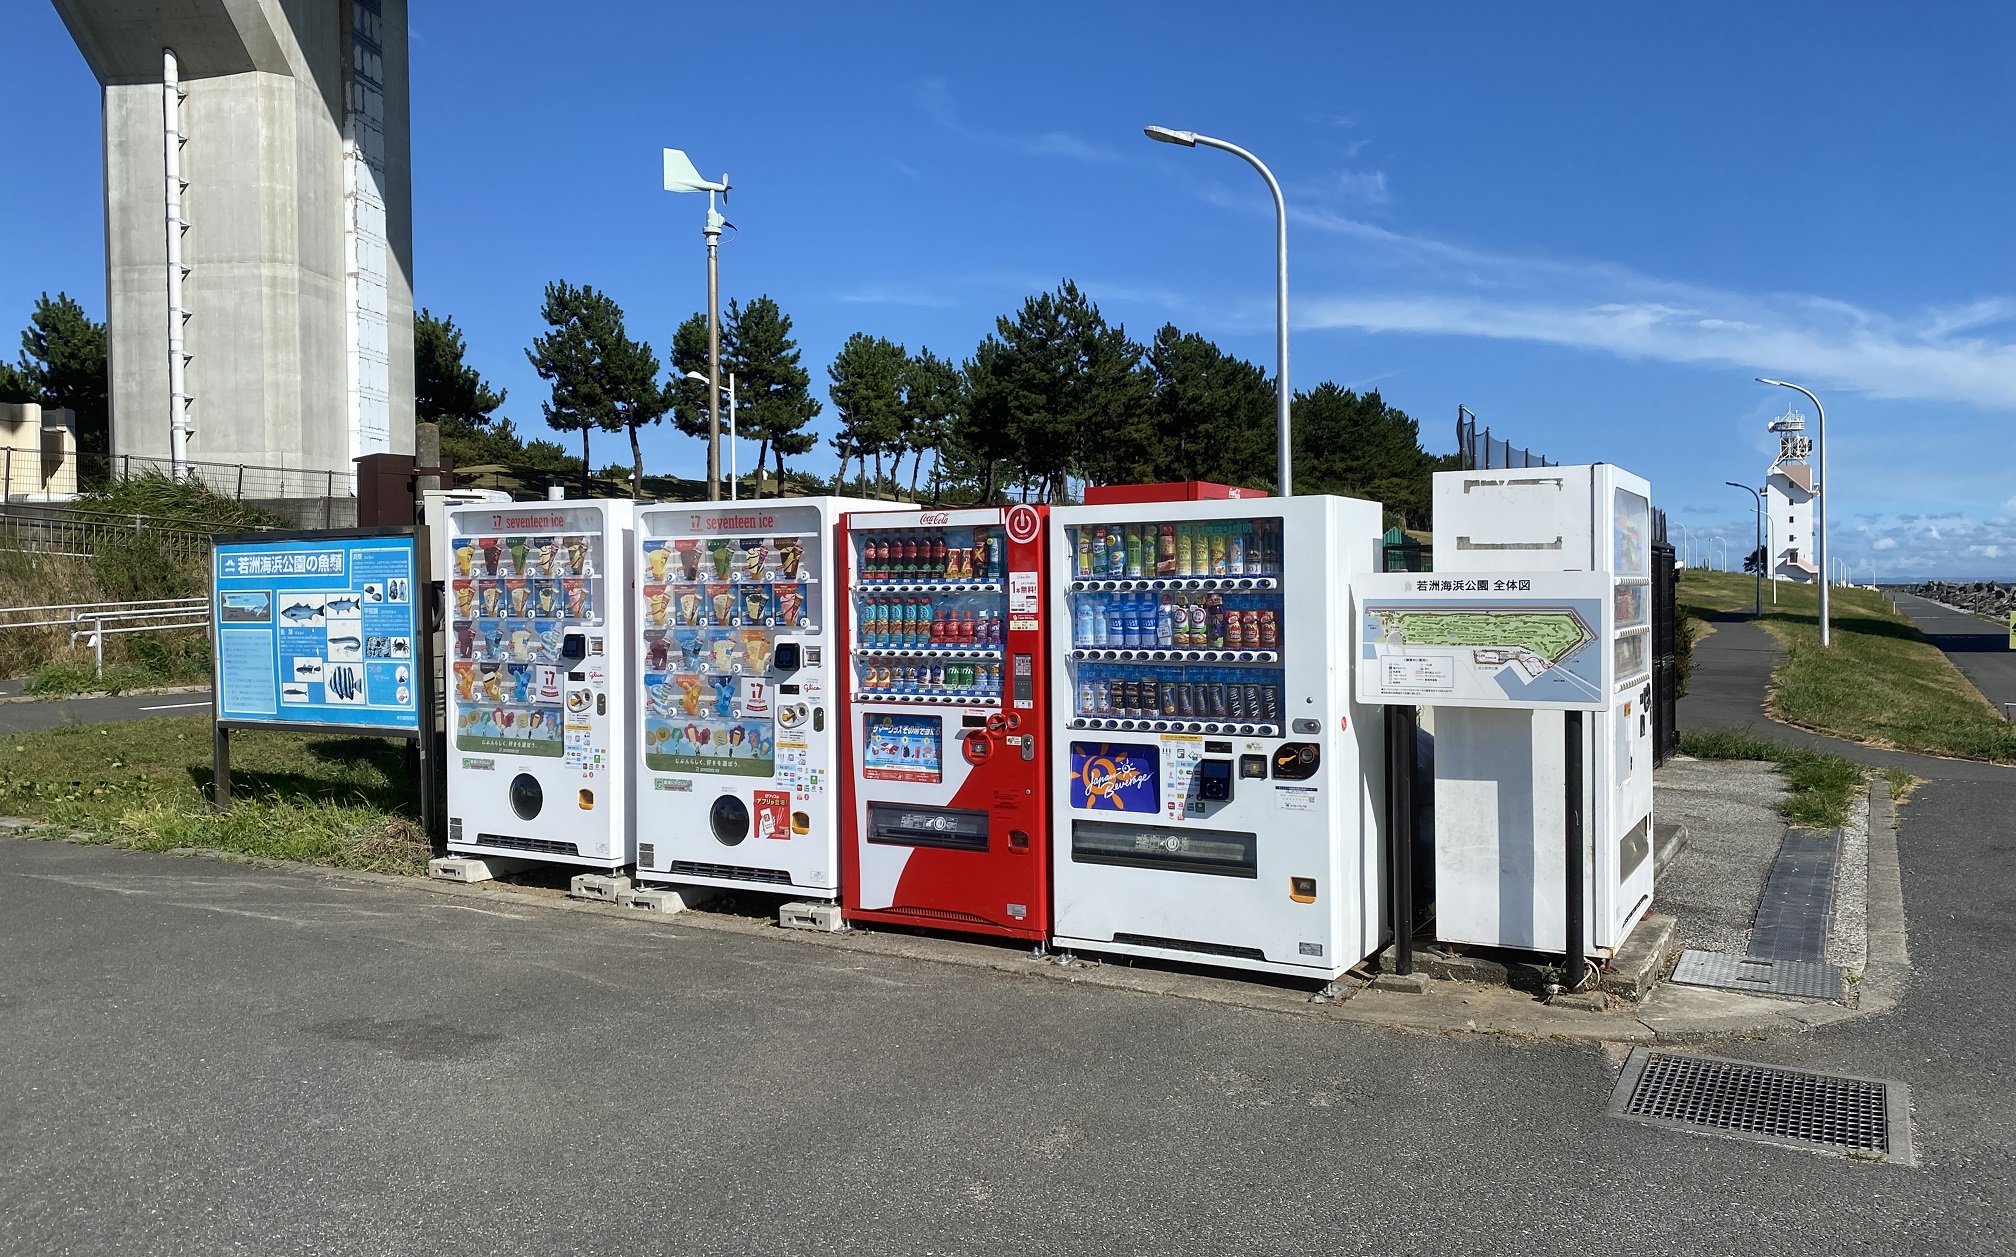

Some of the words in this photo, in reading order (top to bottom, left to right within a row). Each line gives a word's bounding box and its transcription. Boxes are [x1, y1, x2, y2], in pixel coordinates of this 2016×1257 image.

[506, 515, 548, 528] seventeen
[550, 512, 564, 527] ice
[706, 515, 756, 529] seventeen
[758, 512, 774, 528] ice
[237, 554, 342, 574] 若洲海浜公園の魚類
[1416, 579, 1489, 591] 若洲海浜公園
[1493, 579, 1531, 591] 全体図
[589, 671, 604, 679] Glico
[803, 684, 822, 692] Glico
[1085, 771, 1122, 797] Japan
[1100, 771, 1155, 799] Beverage
